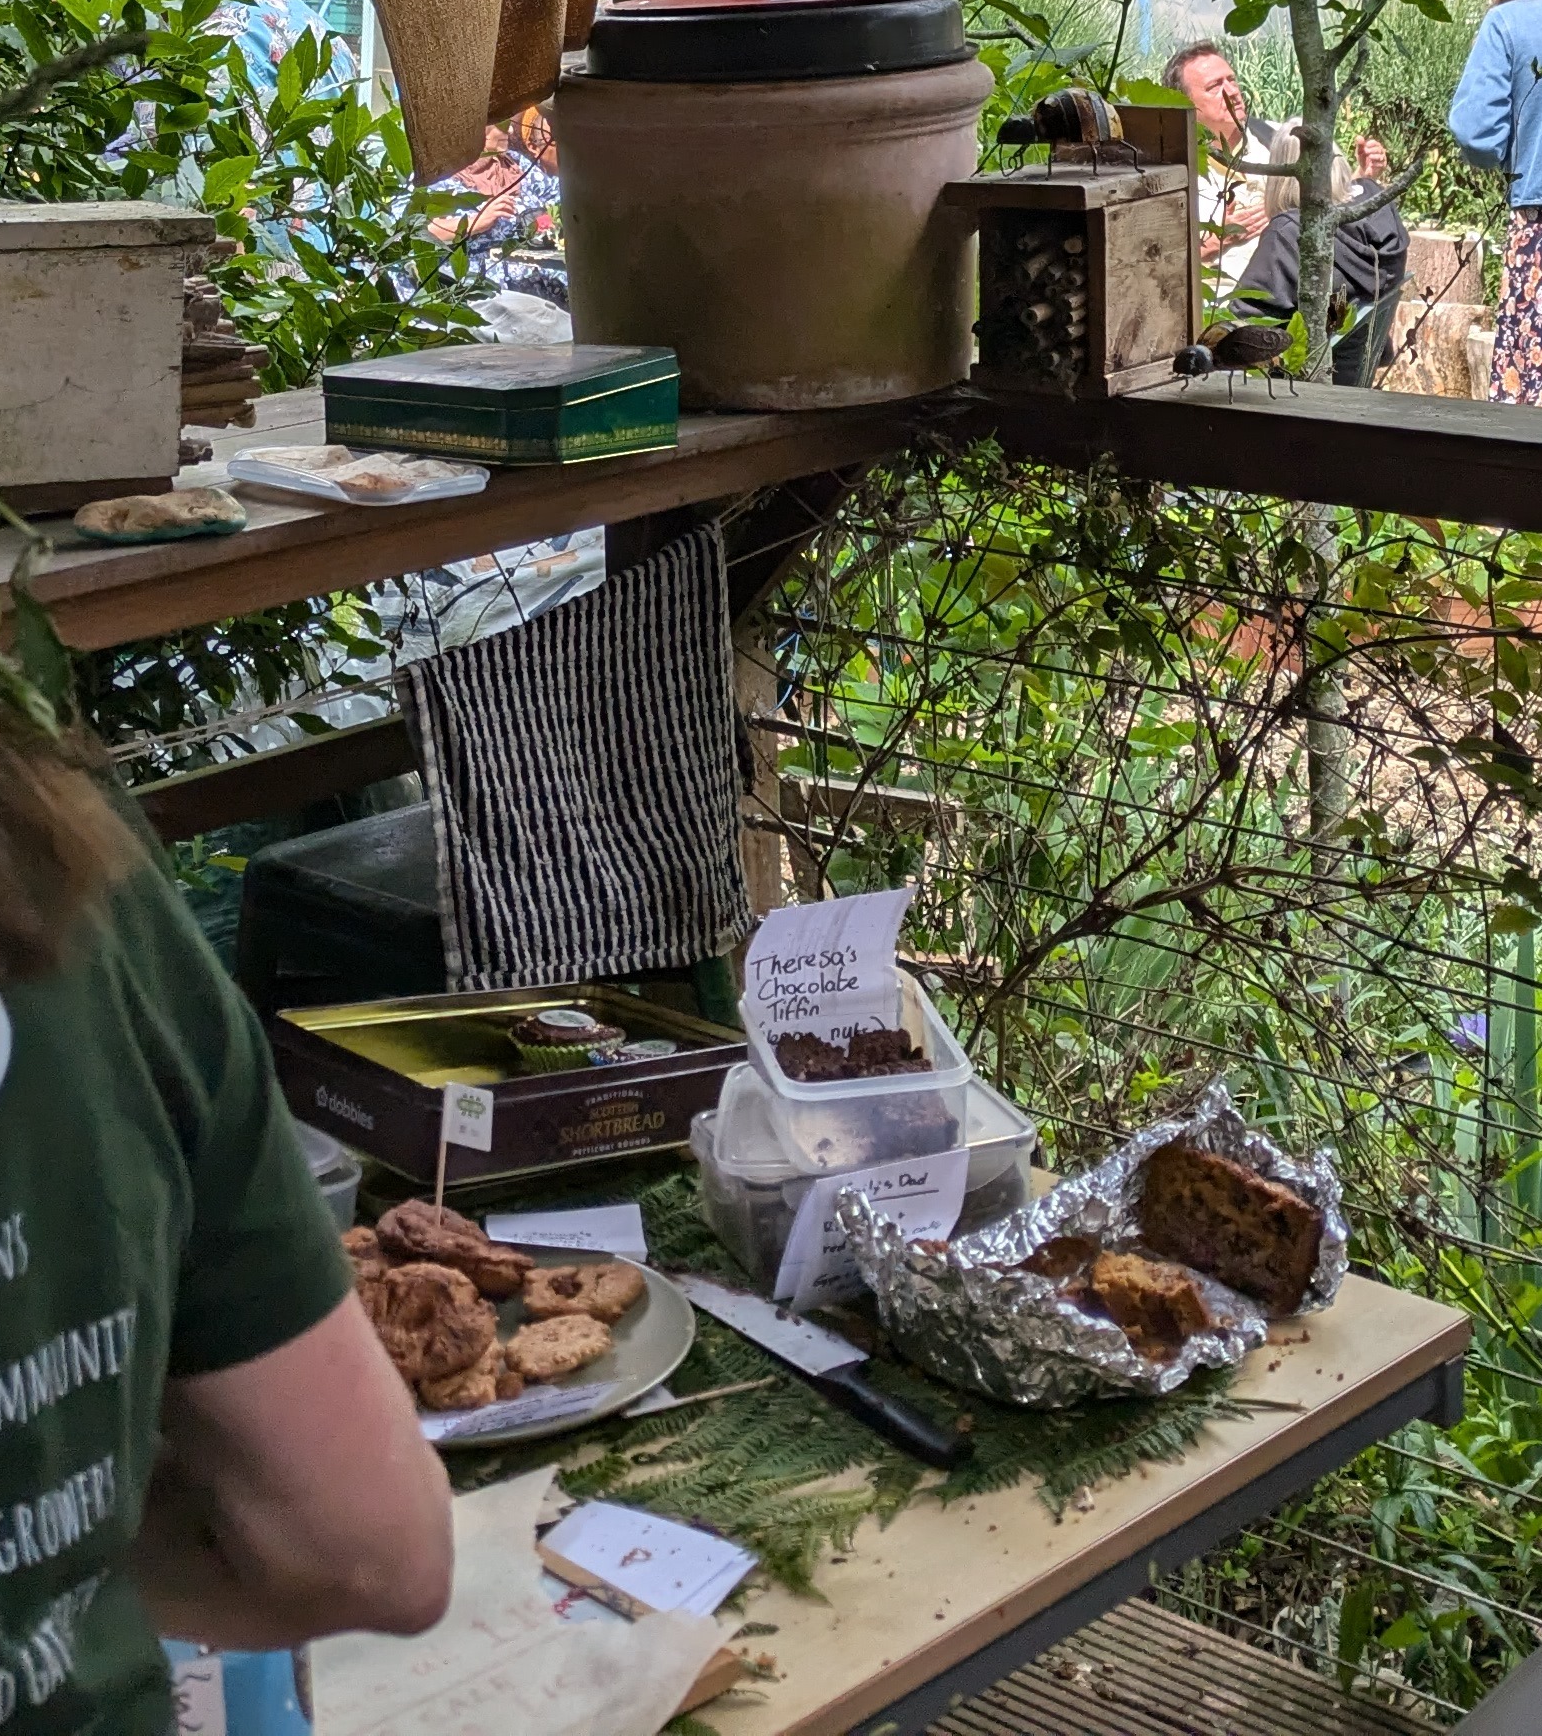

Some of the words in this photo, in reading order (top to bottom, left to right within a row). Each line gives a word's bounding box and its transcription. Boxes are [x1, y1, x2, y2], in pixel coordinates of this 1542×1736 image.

[750, 945, 858, 980] Theresa's
[758, 967, 860, 1001] Chocolate
[766, 993, 821, 1023] Tiffin
[328, 1093, 375, 1131] dobbies
[560, 1110, 666, 1144] SHORTBREAD
